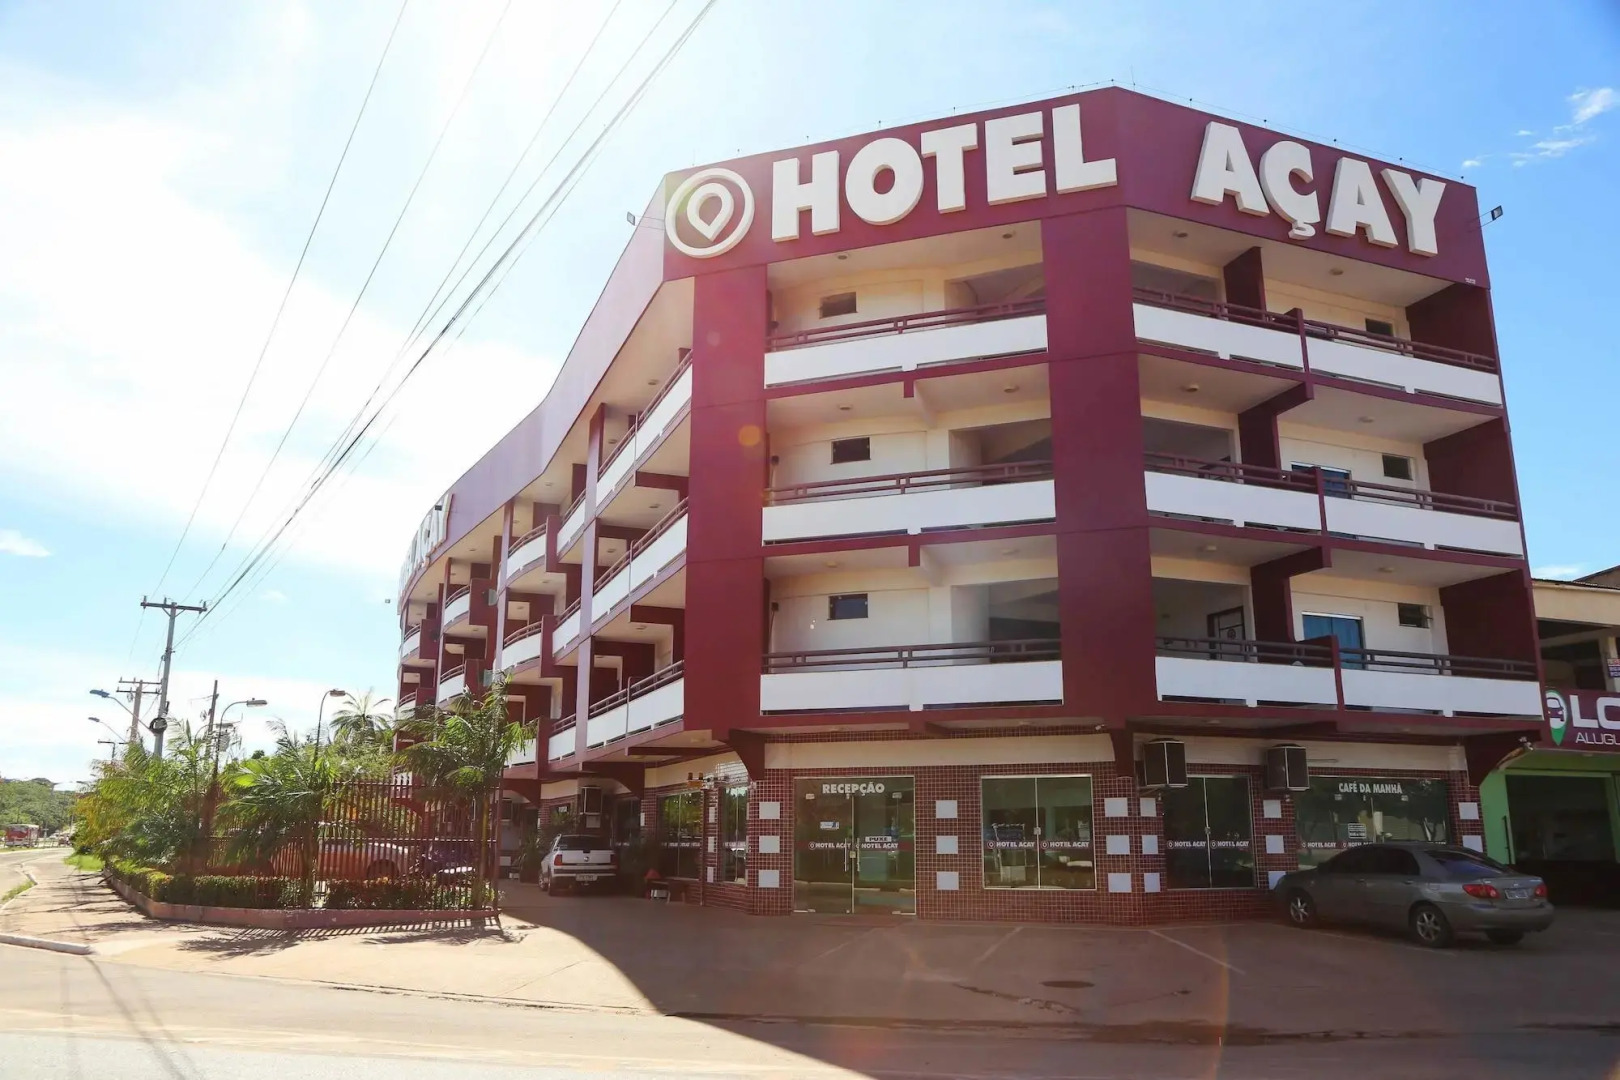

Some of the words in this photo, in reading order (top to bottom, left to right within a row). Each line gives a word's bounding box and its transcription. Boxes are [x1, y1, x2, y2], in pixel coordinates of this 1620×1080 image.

[772, 103, 1118, 243] HOTEL
[1190, 121, 1446, 258] AÇAY
[822, 781, 885, 797] RECEPÇÃO
[1338, 781, 1358, 793] CAFÉ
[1359, 783, 1371, 793] DA
[1372, 782, 1403, 794] MANHÃ
